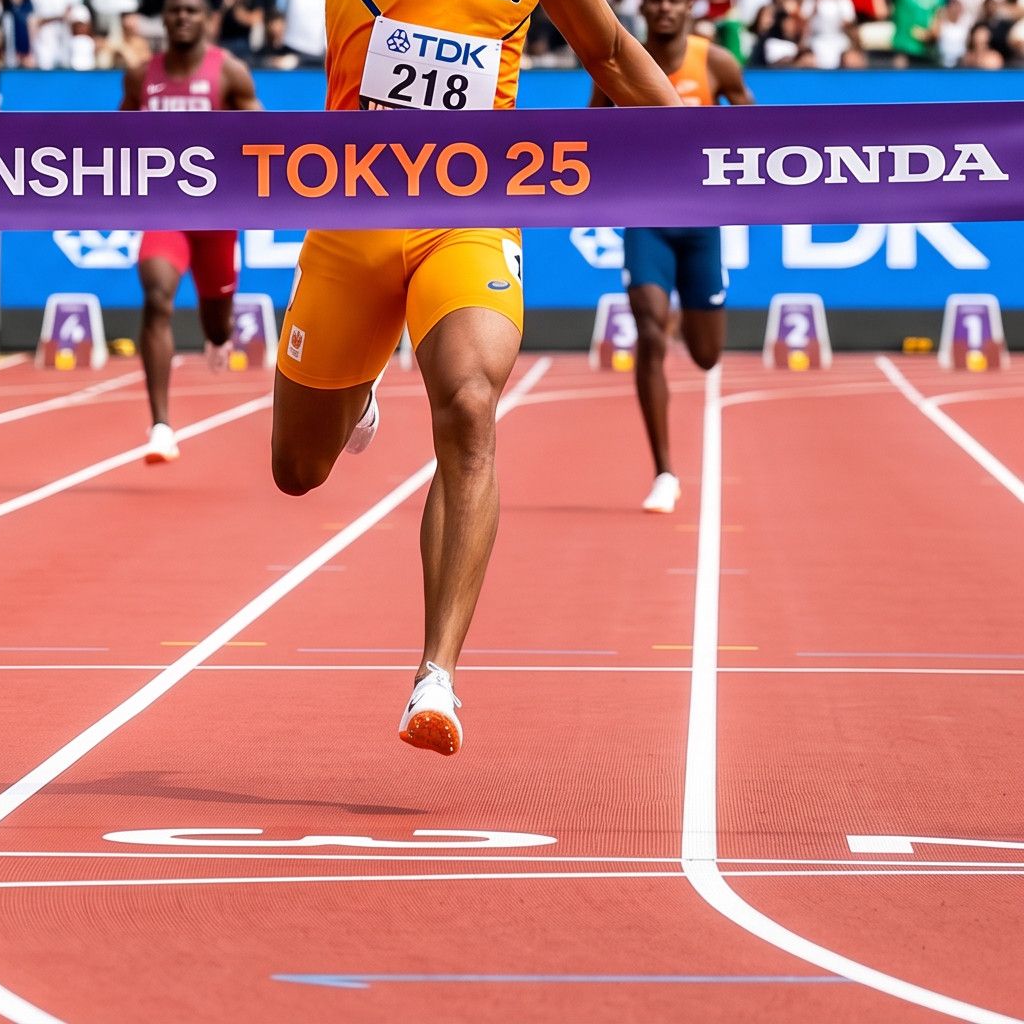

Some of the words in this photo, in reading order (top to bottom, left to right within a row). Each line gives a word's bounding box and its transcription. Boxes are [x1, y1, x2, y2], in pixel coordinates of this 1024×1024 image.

[412, 32, 489, 70] TDK
[387, 63, 470, 110] 218
[242, 141, 491, 199] TOKYO
[505, 141, 593, 197] 25
[702, 144, 1010, 186] HONDA
[783, 314, 812, 348] 2
[962, 314, 983, 347] 1
[102, 827, 559, 850] 3
